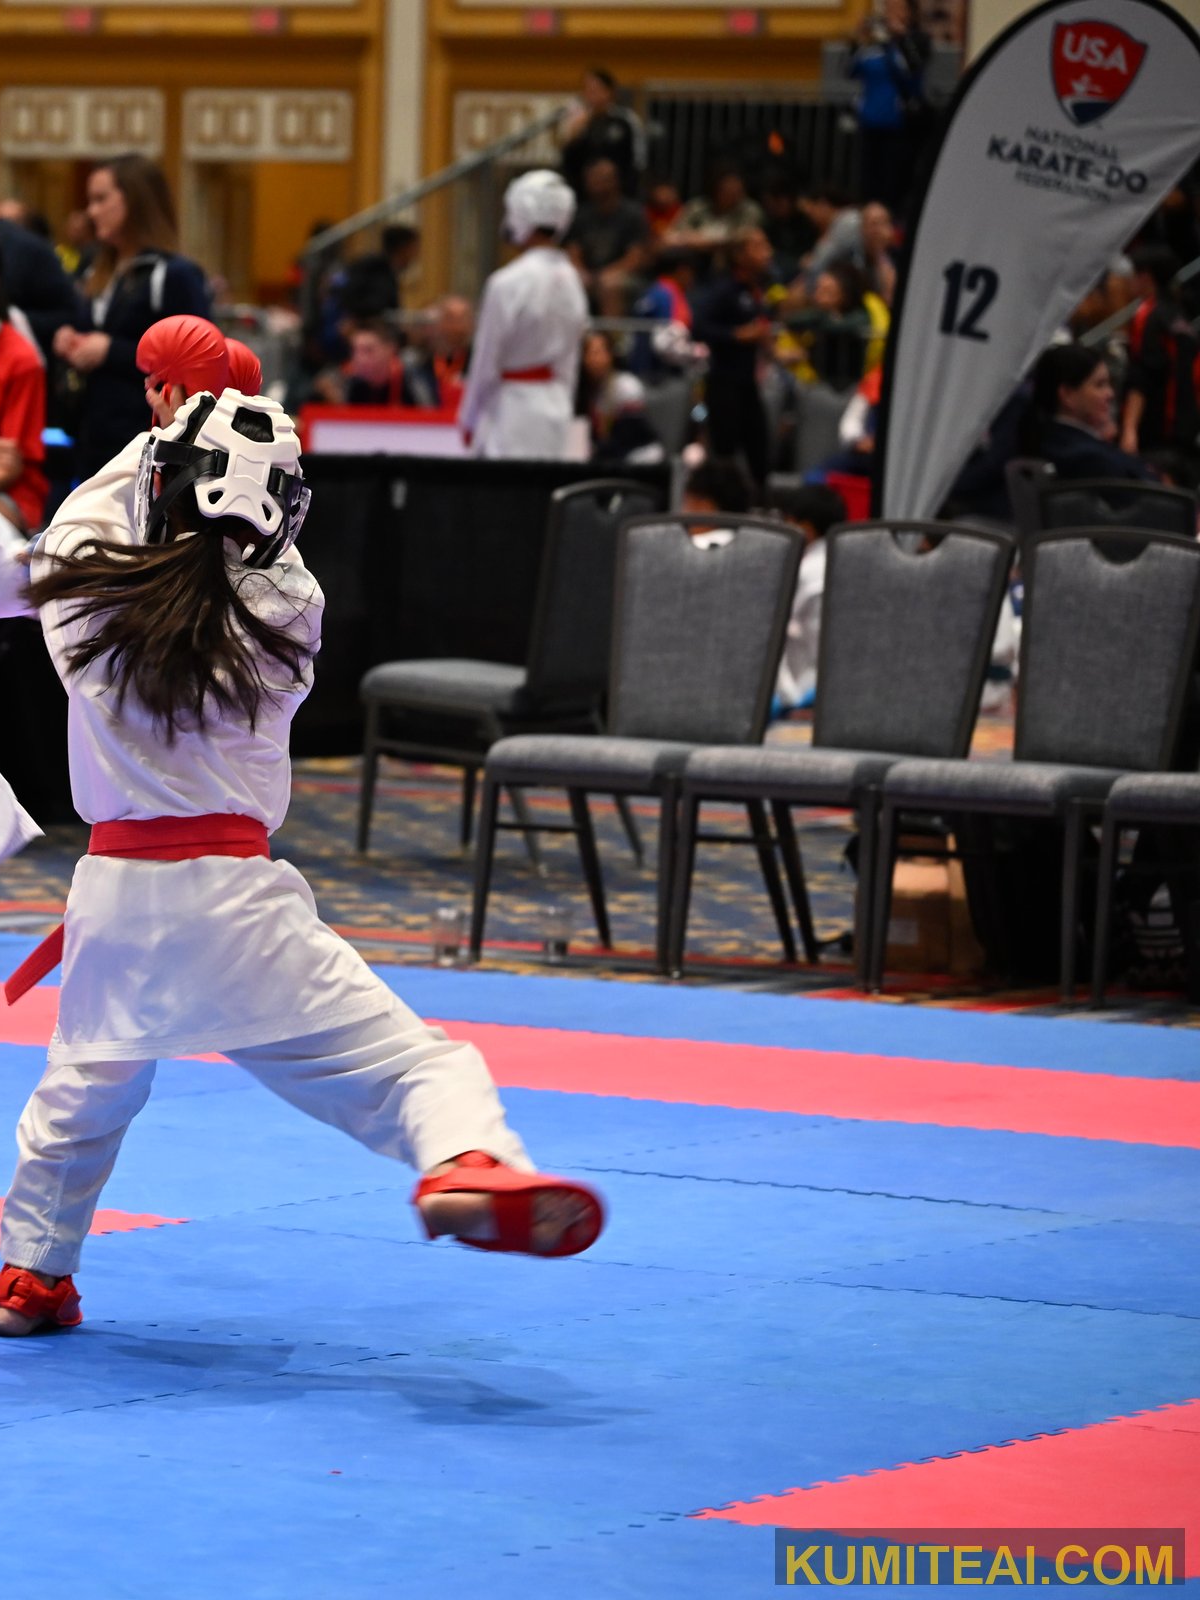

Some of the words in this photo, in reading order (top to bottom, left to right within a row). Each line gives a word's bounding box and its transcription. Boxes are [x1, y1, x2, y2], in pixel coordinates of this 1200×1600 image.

[1061, 29, 1128, 74] USA
[987, 133, 1148, 194] KARATE-DO
[940, 260, 1000, 341] 12
